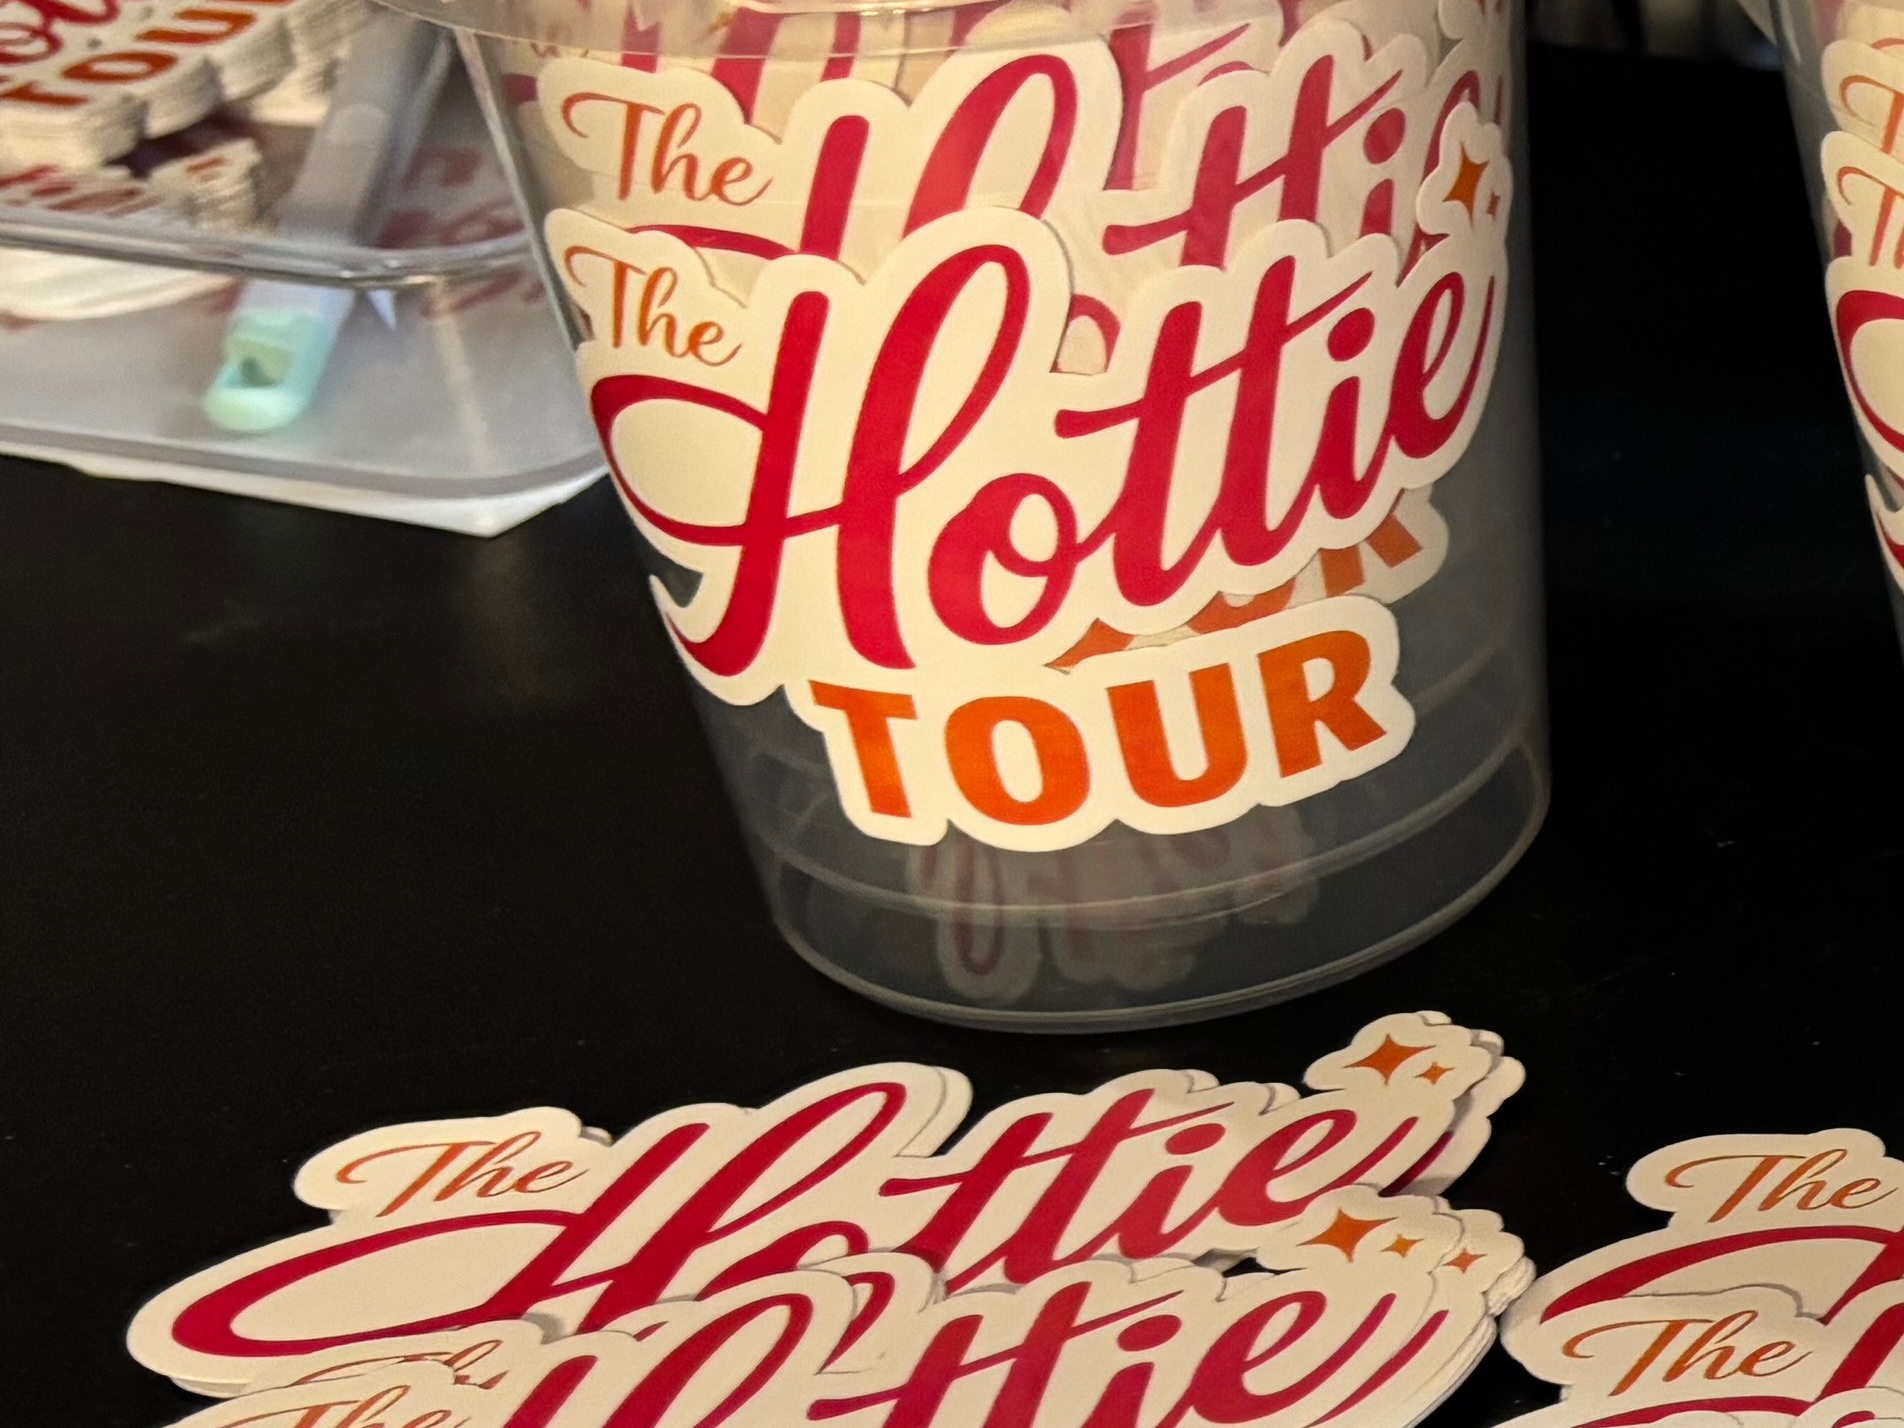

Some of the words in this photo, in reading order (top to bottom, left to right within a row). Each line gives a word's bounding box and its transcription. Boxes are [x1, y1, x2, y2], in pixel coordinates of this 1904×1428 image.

[560, 92, 773, 207] The
[562, 244, 738, 368] The
[590, 242, 1496, 677] Hottie
[810, 629, 1387, 826] TOUR
[335, 1129, 588, 1217] The
[1664, 1146, 1898, 1224] The
[1560, 1310, 1810, 1398] The
